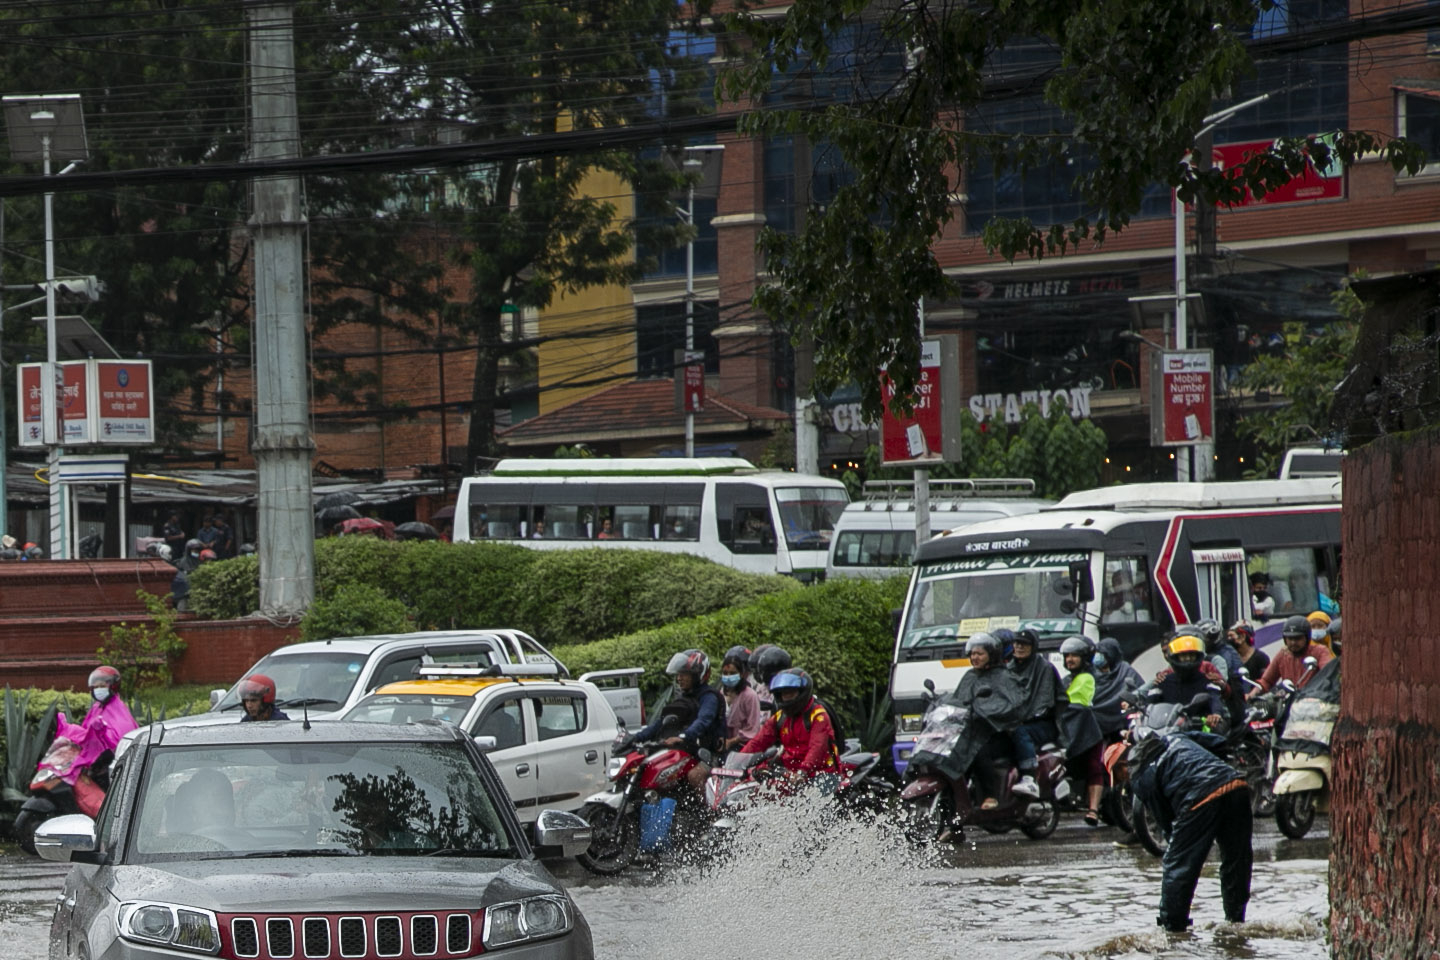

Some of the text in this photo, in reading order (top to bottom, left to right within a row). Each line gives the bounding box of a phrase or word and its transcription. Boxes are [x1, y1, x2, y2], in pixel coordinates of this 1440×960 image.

[1004, 279, 1071, 298] HELMETS
[1173, 373, 1203, 383] Mobile
[1170, 383, 1207, 393] Number
[972, 541, 990, 551] जय
